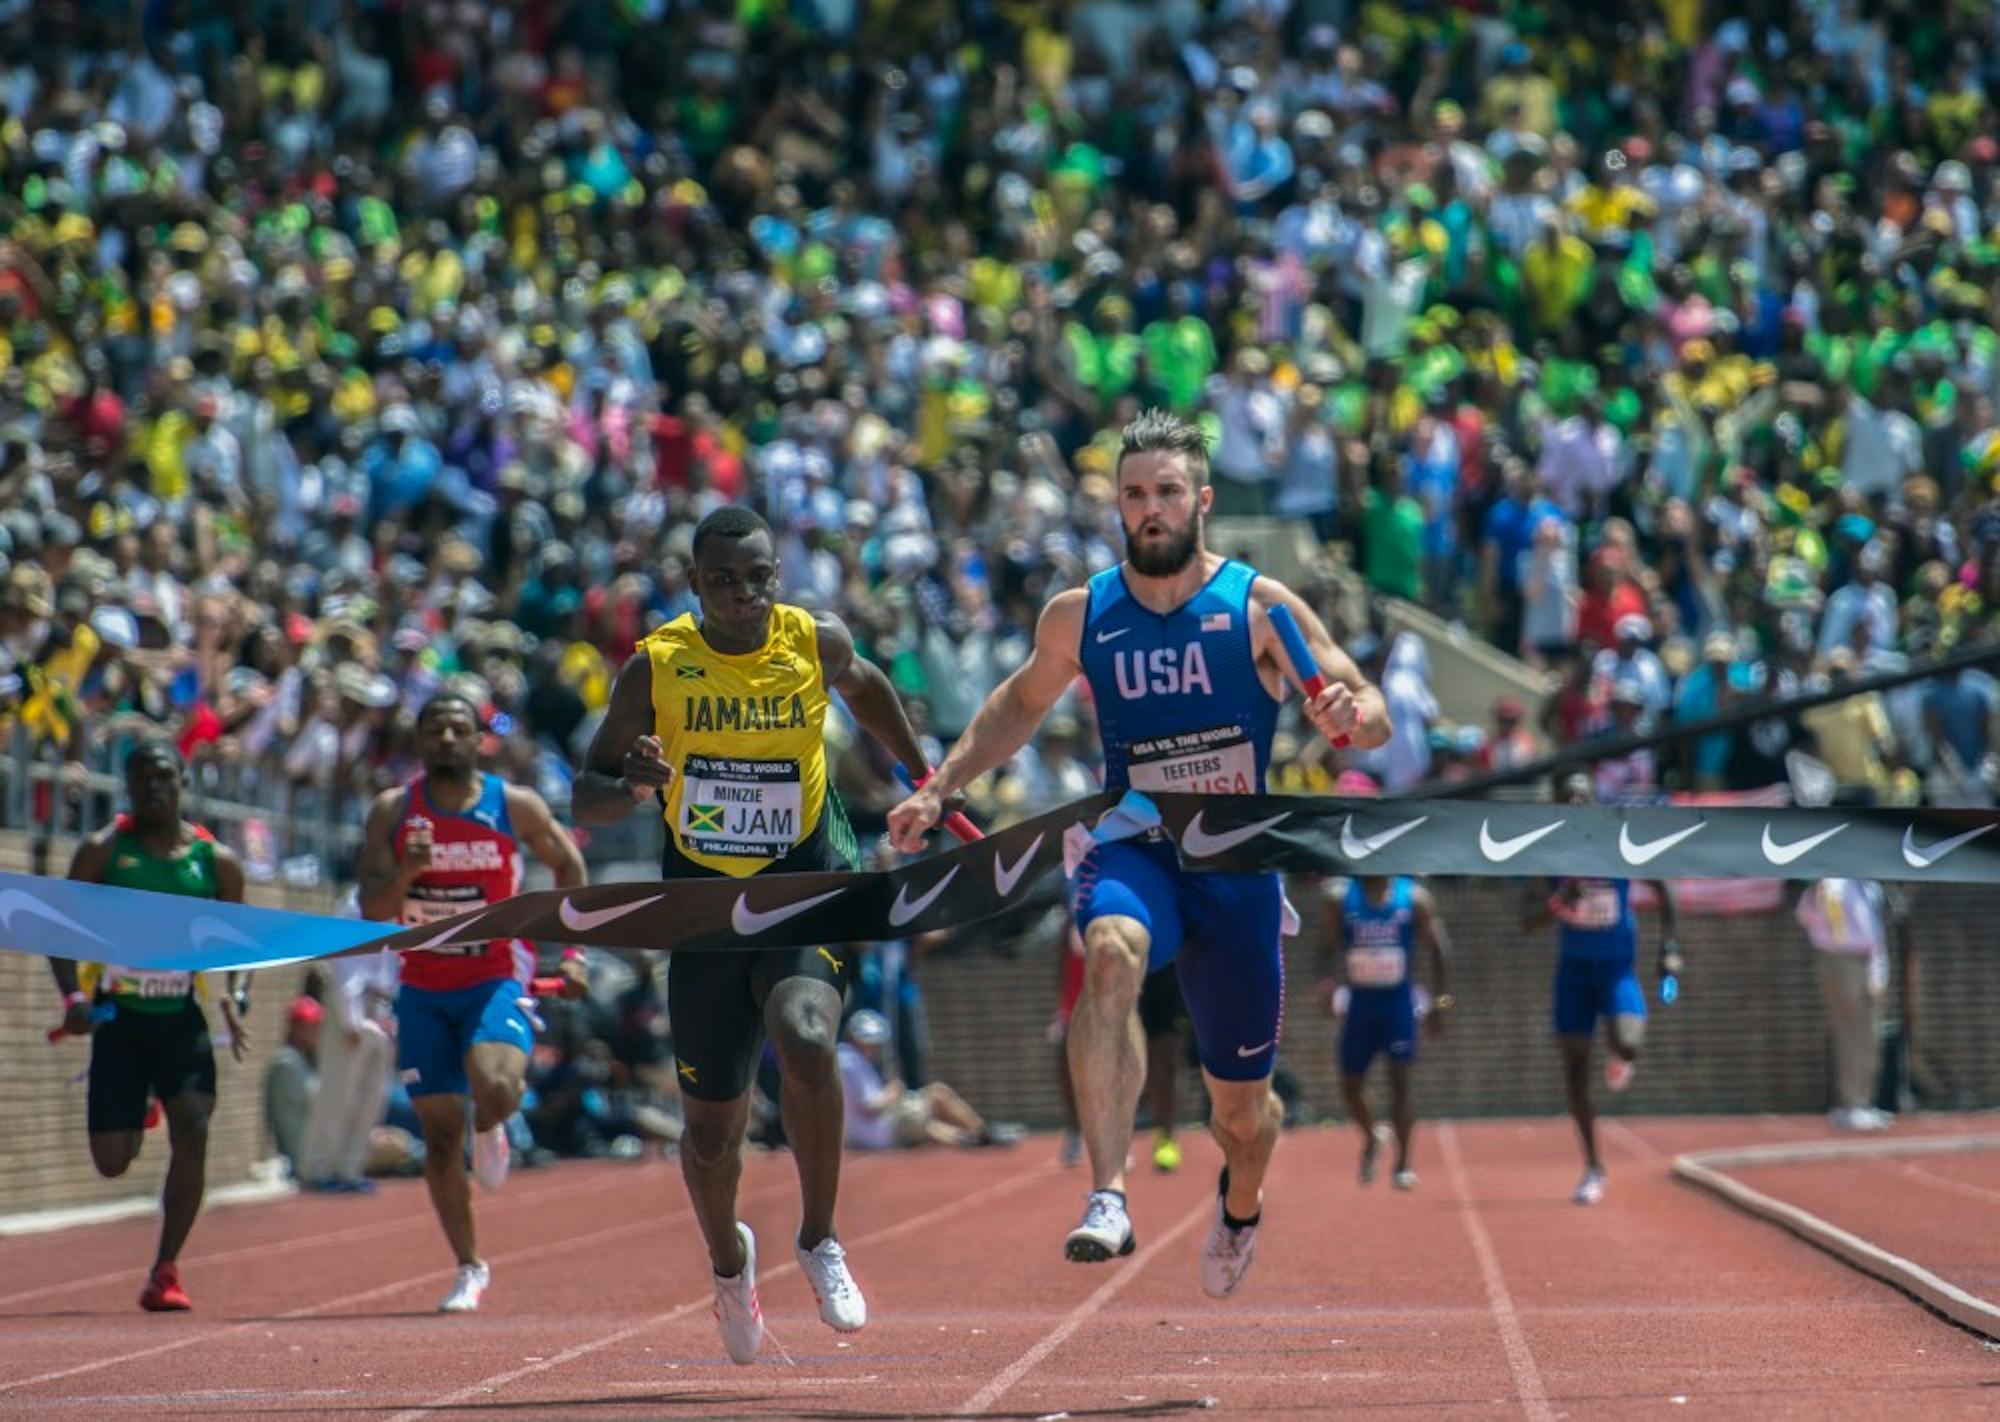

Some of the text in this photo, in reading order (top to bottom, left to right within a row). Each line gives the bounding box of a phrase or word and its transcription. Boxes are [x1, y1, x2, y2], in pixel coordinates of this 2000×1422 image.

[1114, 641, 1213, 699] USA
[684, 694, 806, 732] JAMAICA
[1133, 742, 1156, 756] USA
[1175, 733, 1200, 747] THE
[1200, 724, 1242, 743] WORLD
[730, 763, 751, 773] THE
[754, 763, 793, 774] WORLD
[1162, 756, 1222, 781] TEETERS
[714, 786, 763, 803] MINZIE
[732, 808, 793, 835] JAM
